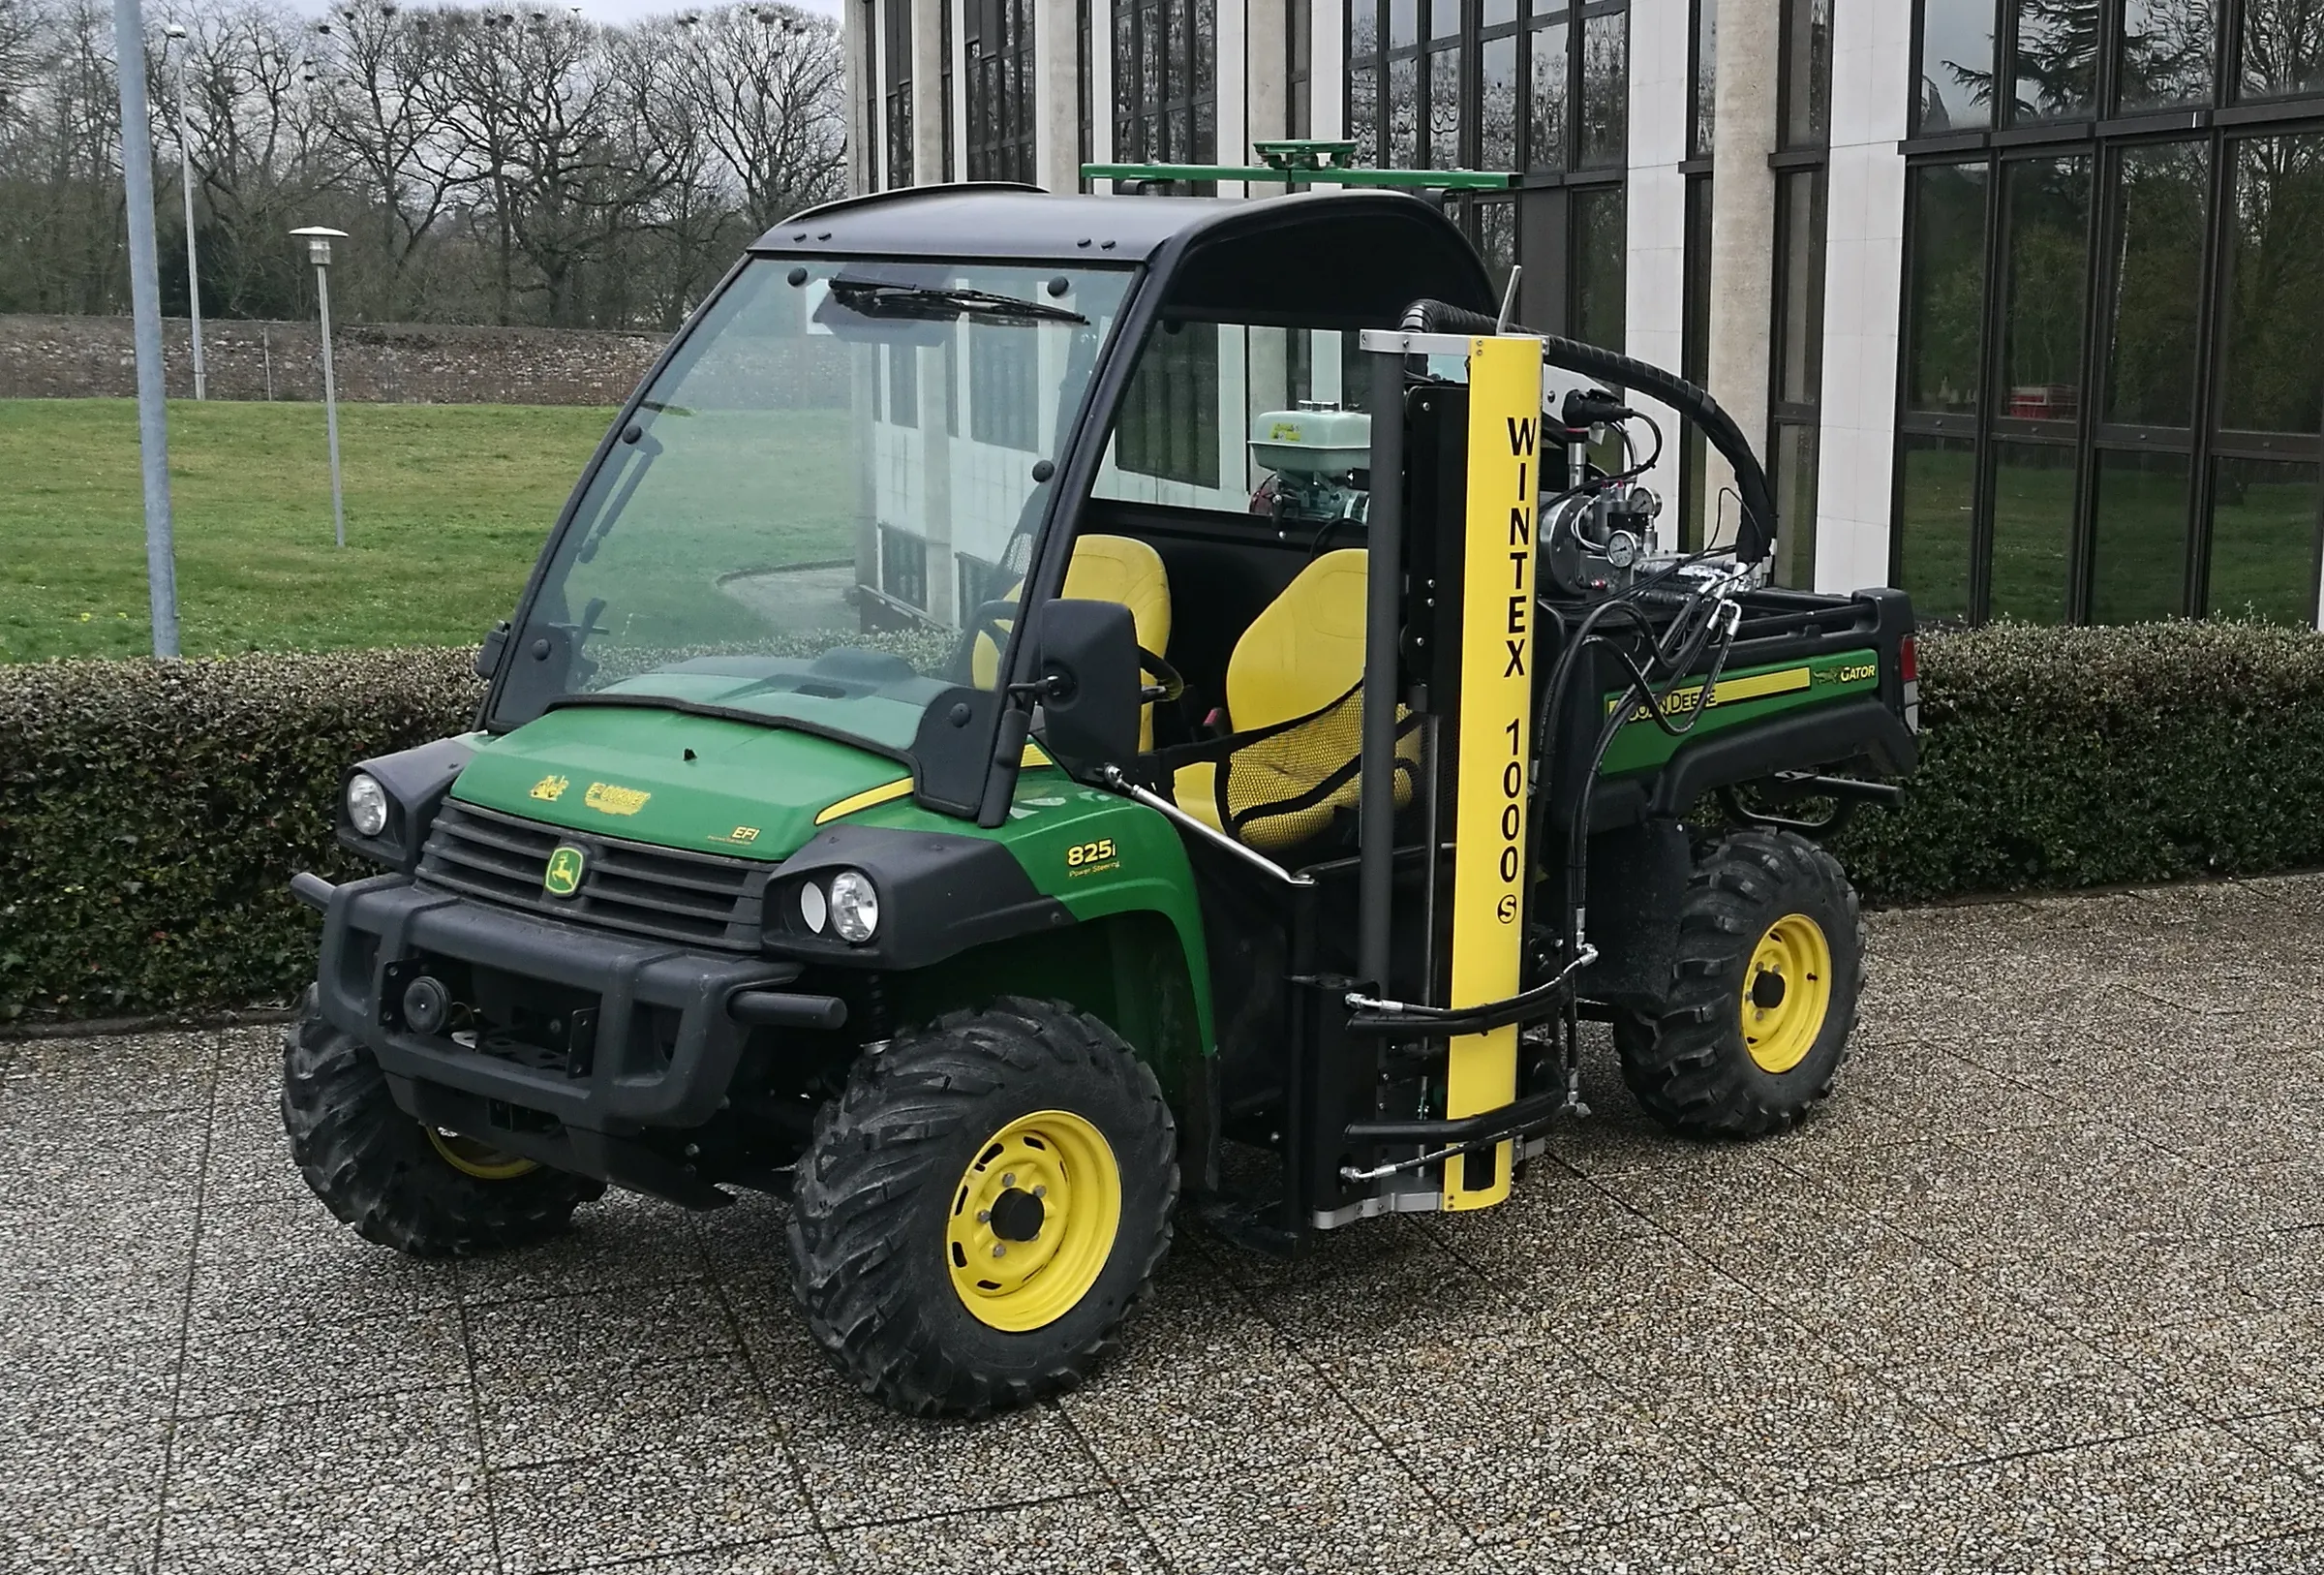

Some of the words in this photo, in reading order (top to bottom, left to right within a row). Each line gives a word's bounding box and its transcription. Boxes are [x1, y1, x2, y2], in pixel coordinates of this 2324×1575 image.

[1504, 417, 1537, 679] WINTEX
[1841, 664, 1876, 682] GATOR
[1499, 717, 1521, 883] 1000
[731, 825, 761, 841] EFI
[1068, 839, 1116, 866] 825i
